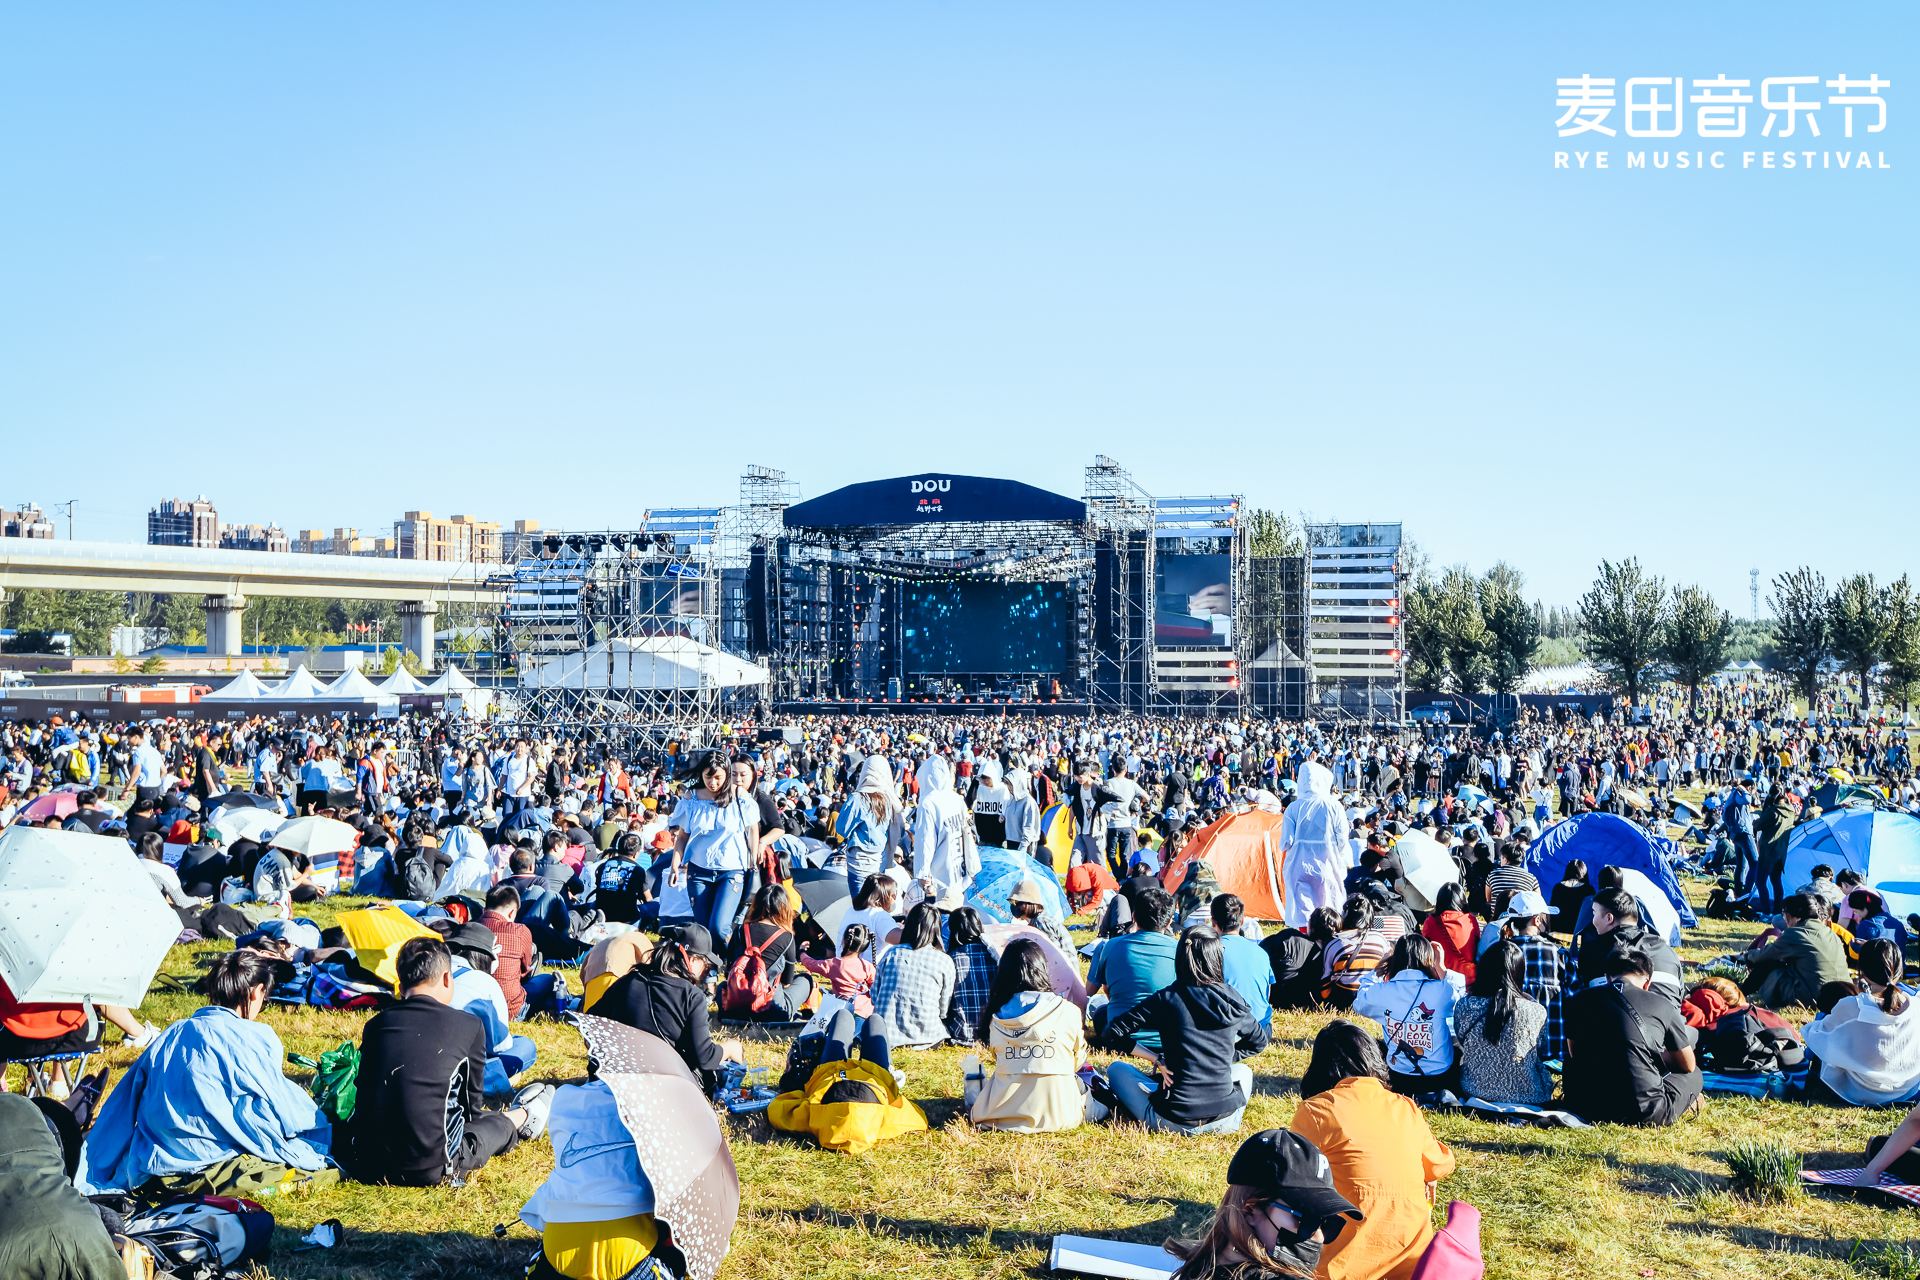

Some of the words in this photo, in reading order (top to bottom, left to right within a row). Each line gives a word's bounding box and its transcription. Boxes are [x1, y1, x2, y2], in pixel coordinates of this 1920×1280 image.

[911, 479, 951, 493] DOU
[1407, 1039, 1432, 1049] NEWS
[1005, 1044, 1055, 1060] BLOOD
